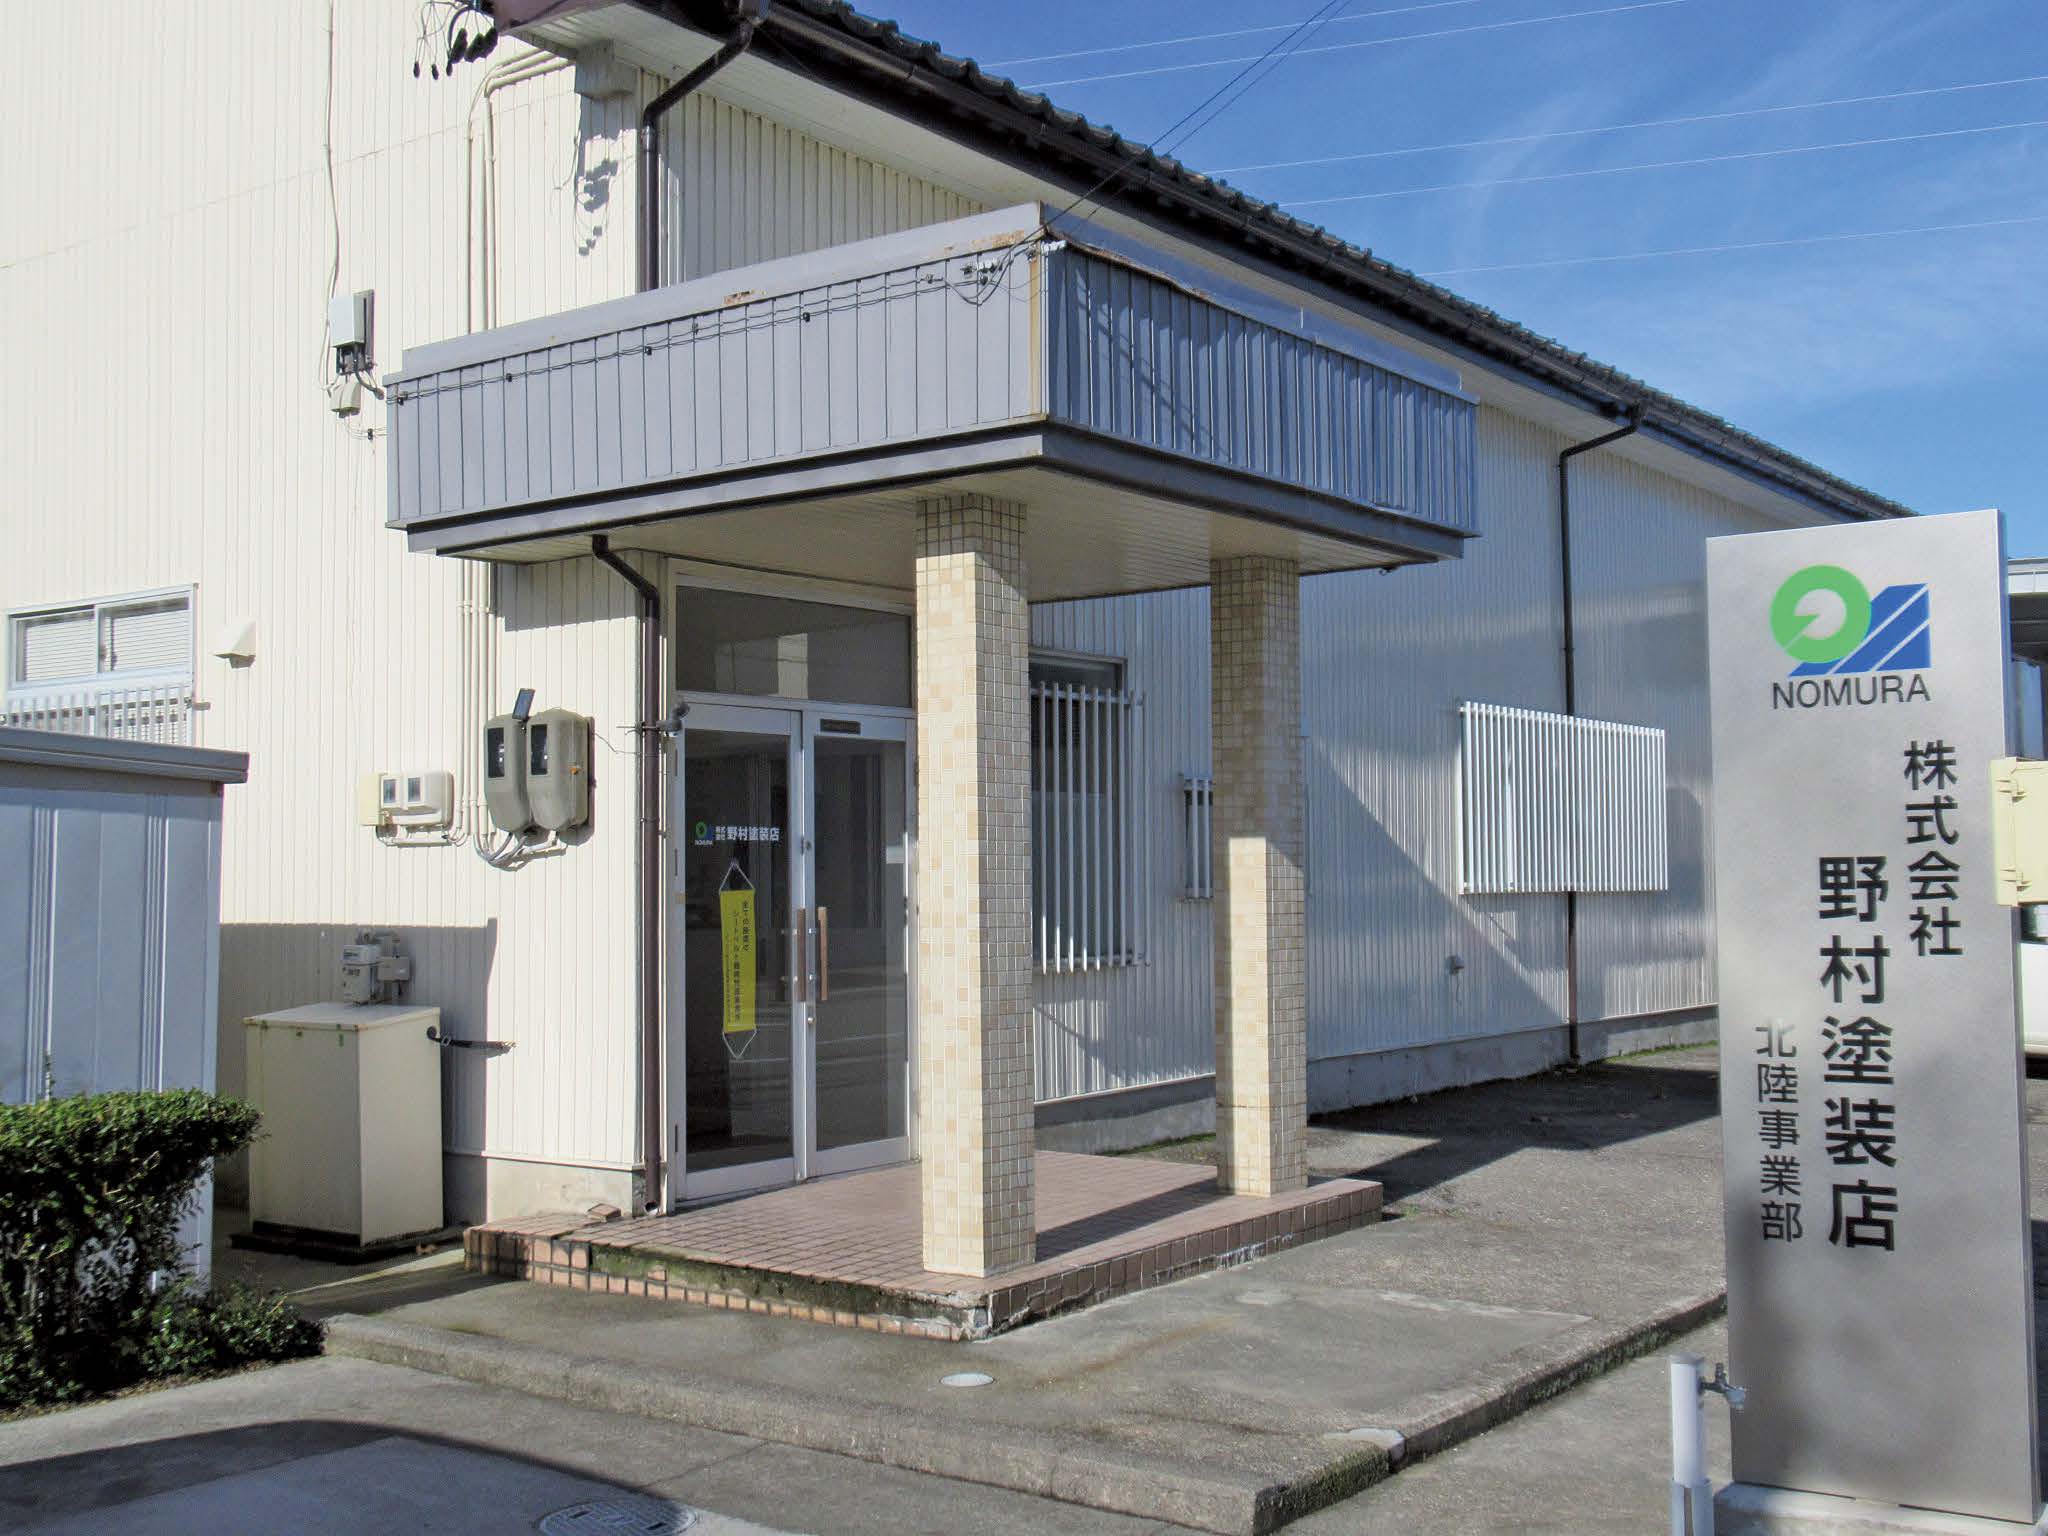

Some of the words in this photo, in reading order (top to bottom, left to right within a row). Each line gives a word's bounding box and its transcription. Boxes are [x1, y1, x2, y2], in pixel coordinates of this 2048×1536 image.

[1772, 673, 1931, 710] NOMURA
[1904, 739, 1963, 956] 株式会社
[1756, 1022, 1803, 1243] 北陸事業部
[1818, 857, 1898, 1251] 野村塗装店
